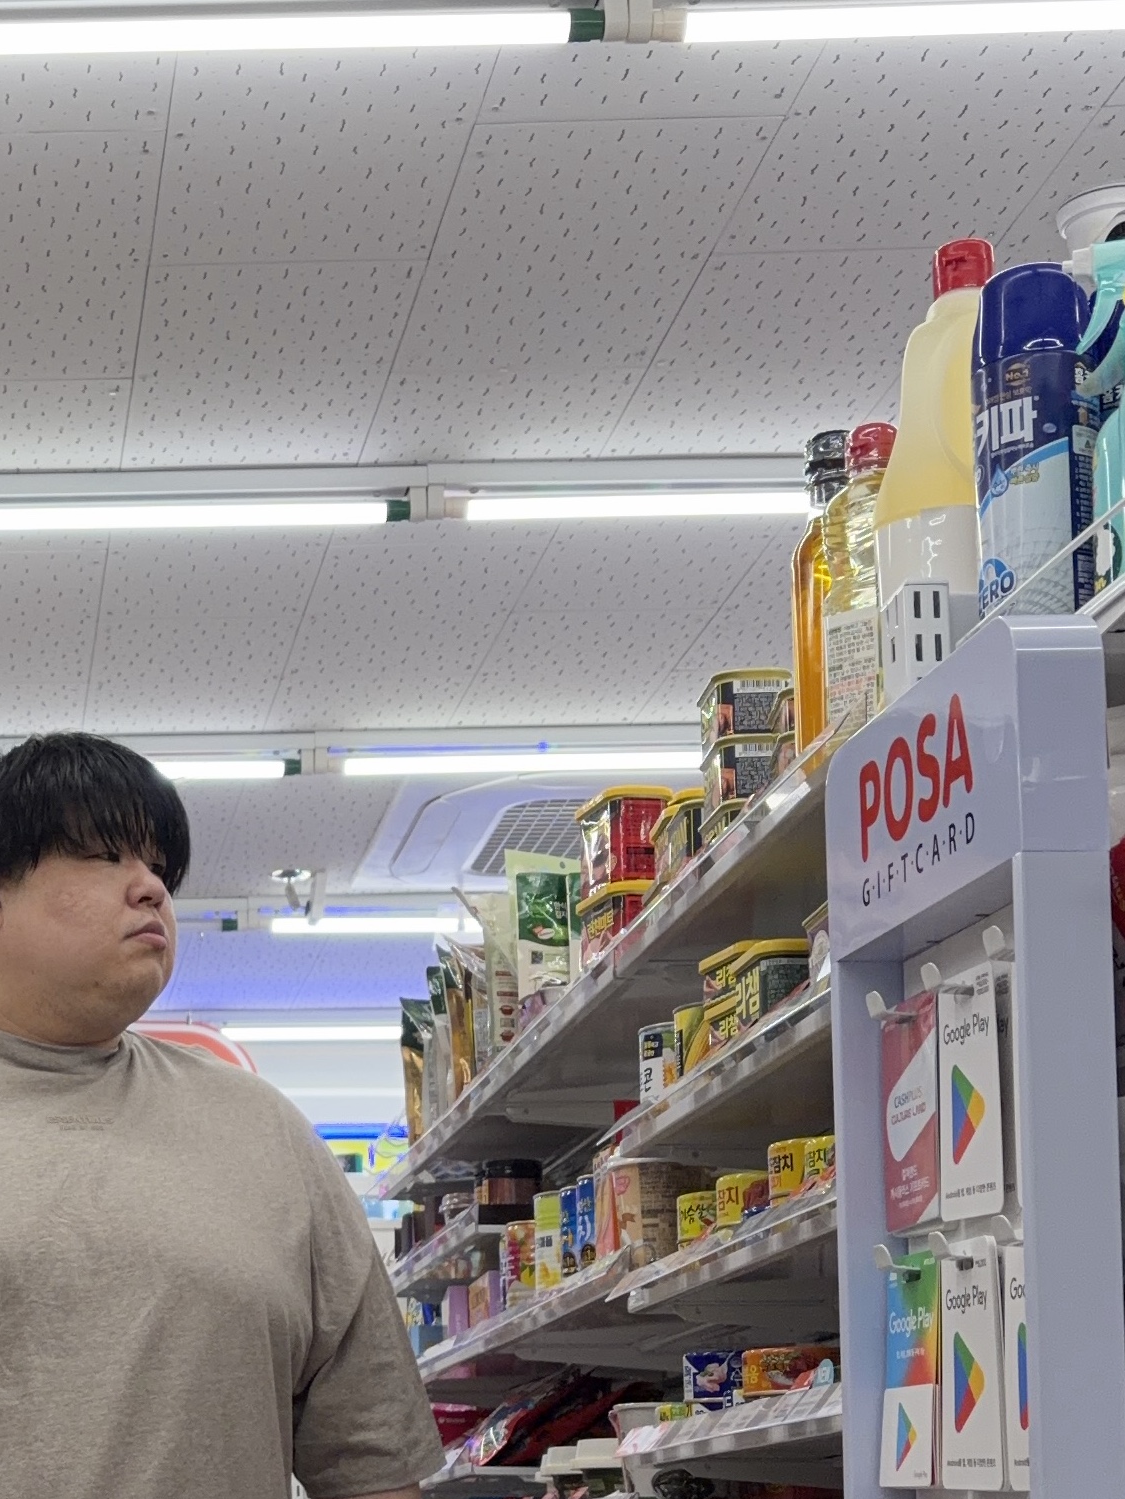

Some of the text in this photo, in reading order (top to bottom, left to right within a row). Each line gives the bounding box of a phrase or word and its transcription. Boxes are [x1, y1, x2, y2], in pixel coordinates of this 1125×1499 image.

[859, 693, 973, 862] POSA
[944, 1012, 990, 1046] Google Play
[946, 1285, 987, 1314] Google Play
[889, 1306, 934, 1338] Google Play
